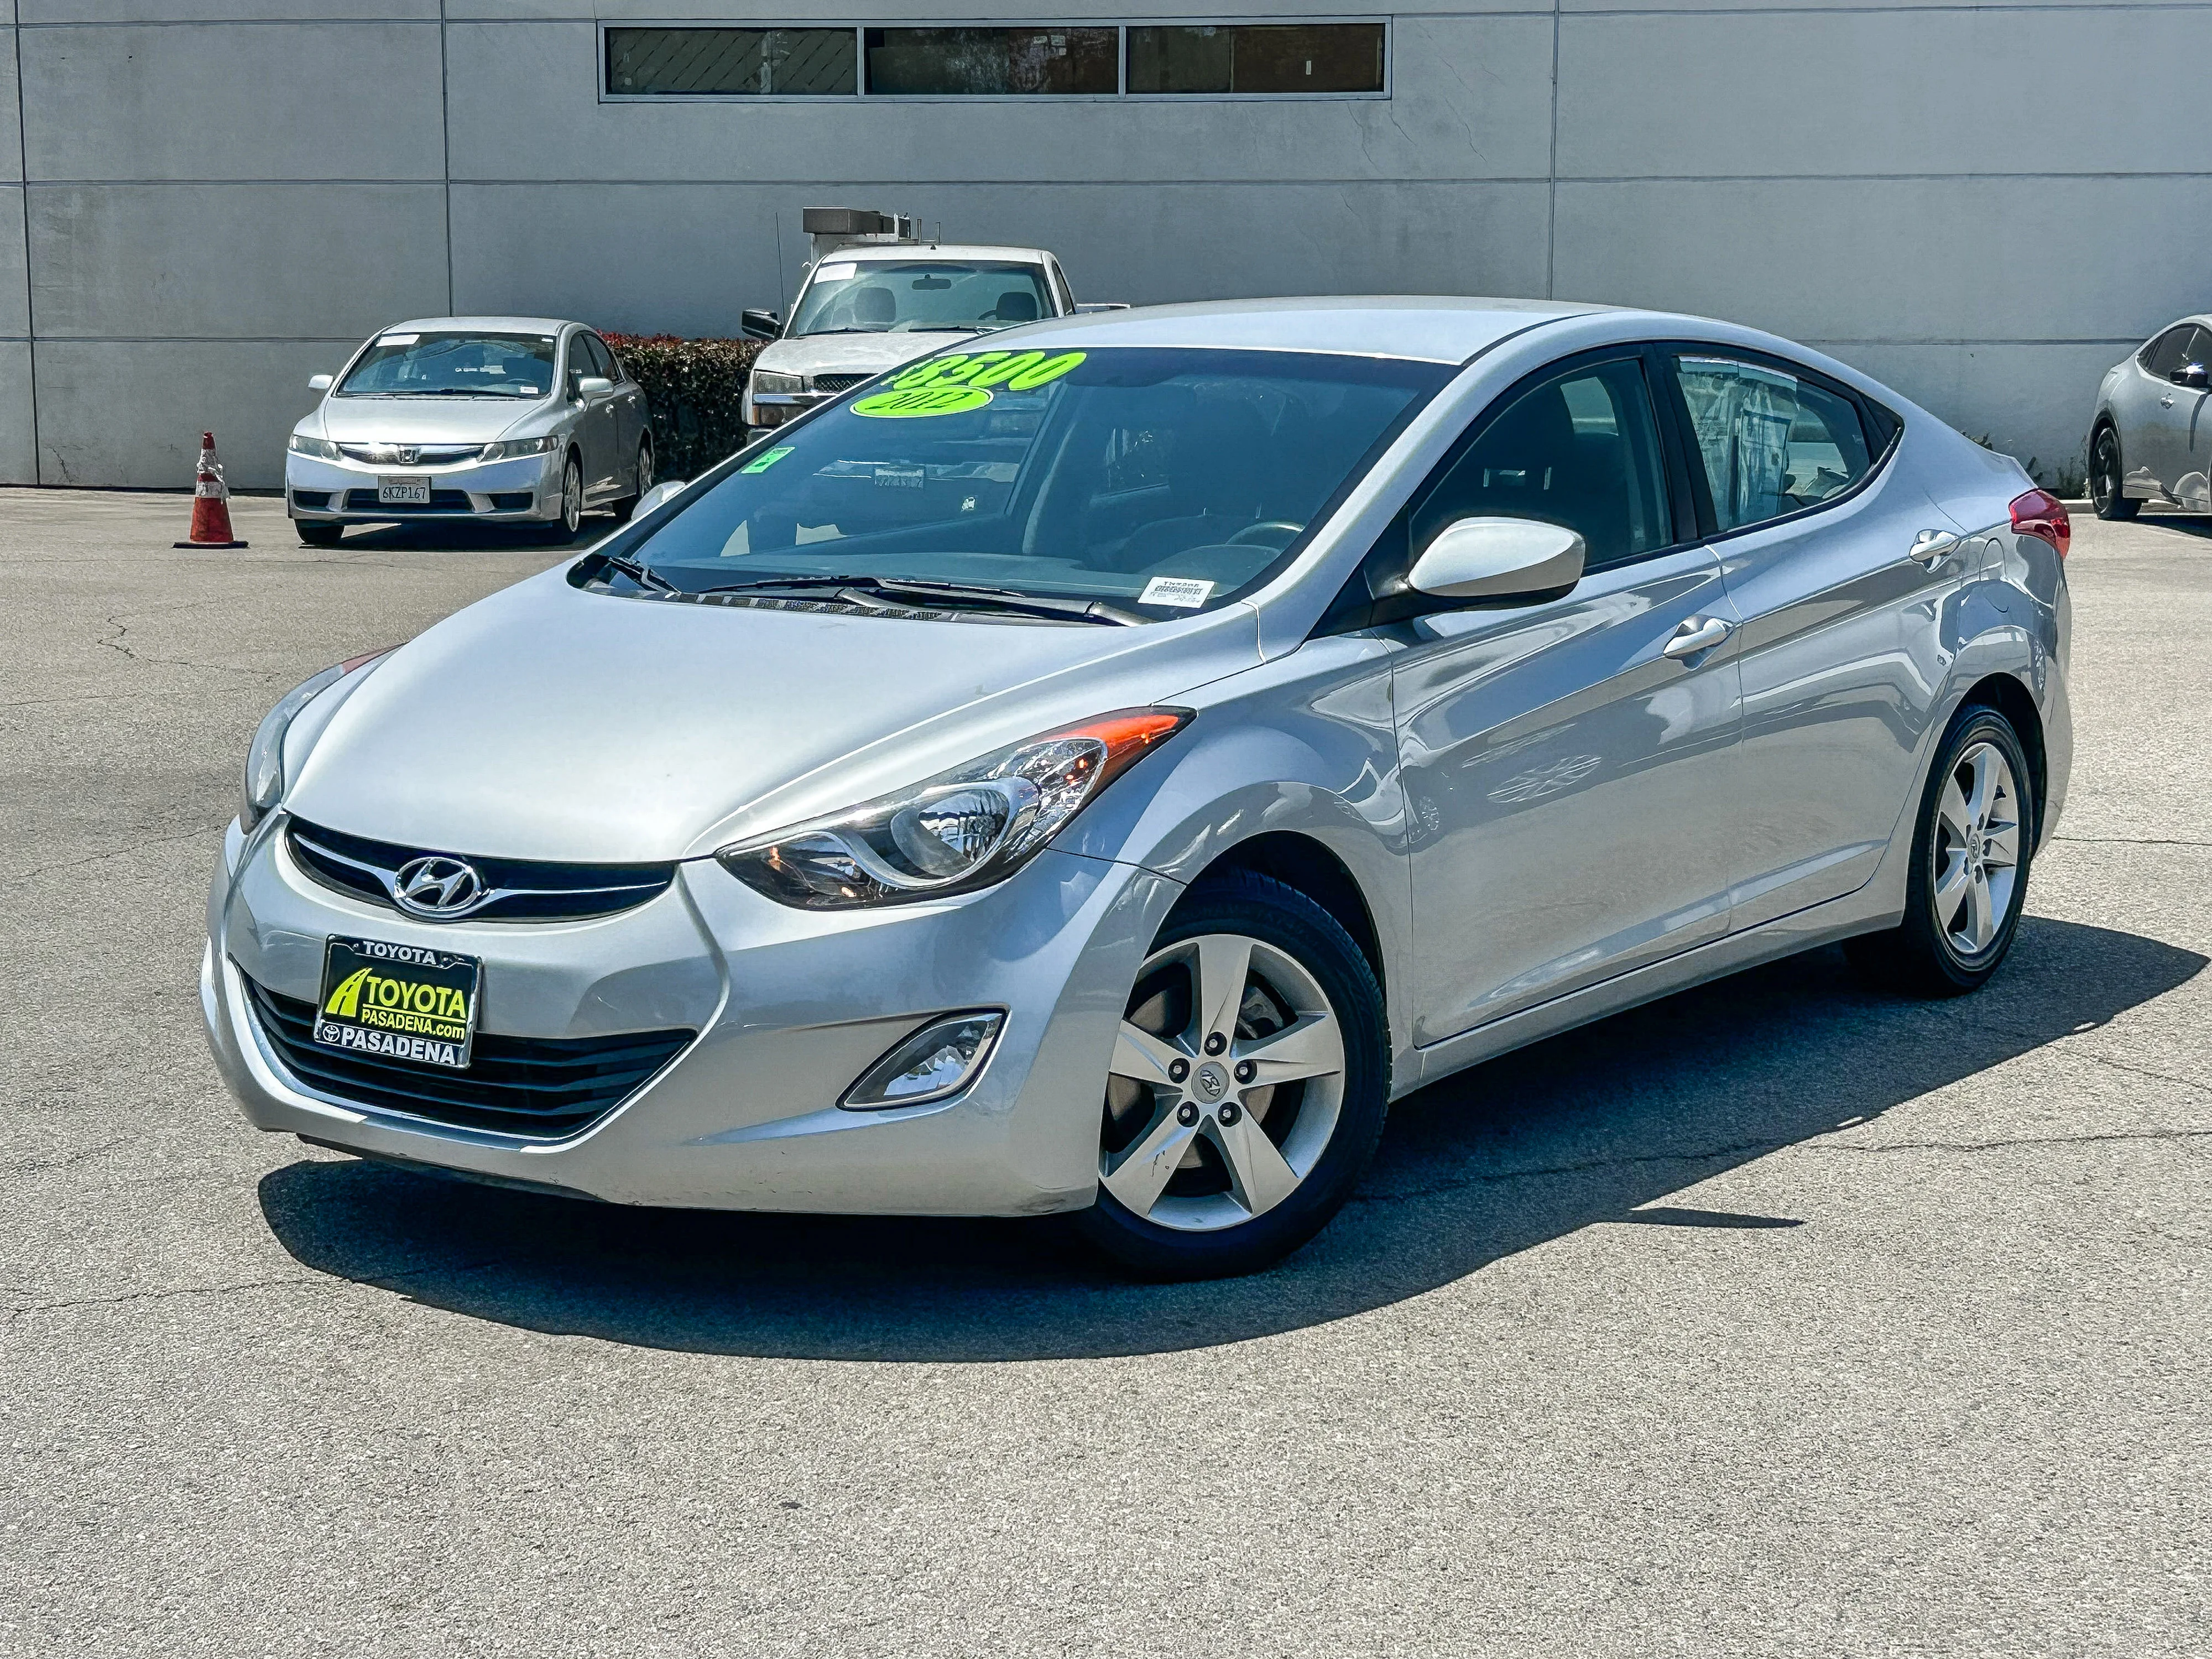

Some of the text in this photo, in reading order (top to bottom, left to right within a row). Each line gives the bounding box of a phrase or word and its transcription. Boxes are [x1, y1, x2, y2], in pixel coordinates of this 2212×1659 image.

[864, 392, 973, 410] 2012
[363, 941, 437, 965] TOYOTA
[366, 975, 467, 1019] TOYOTA
[361, 1008, 466, 1040] PASADENA.com
[341, 1027, 456, 1065] PASADENA
